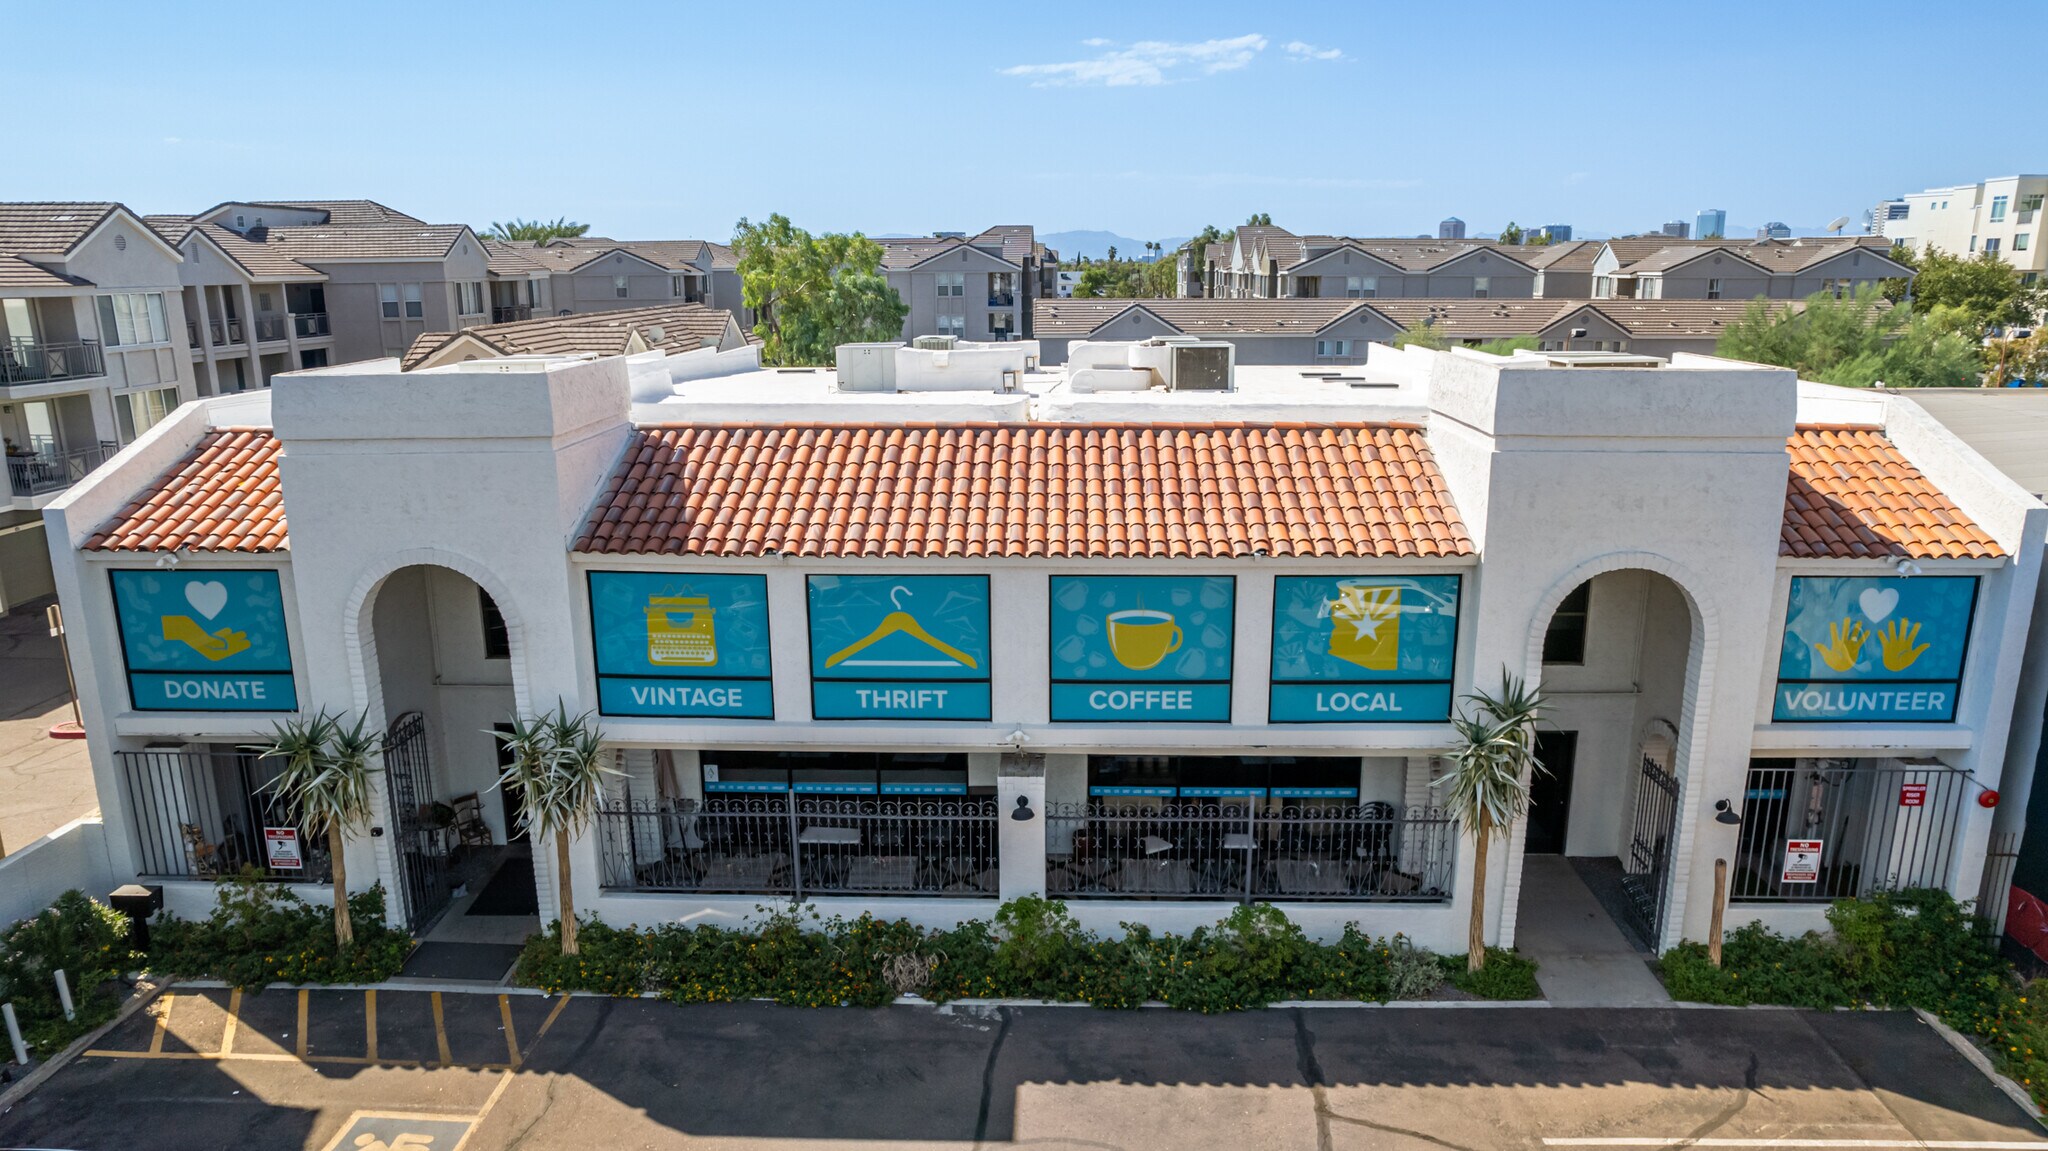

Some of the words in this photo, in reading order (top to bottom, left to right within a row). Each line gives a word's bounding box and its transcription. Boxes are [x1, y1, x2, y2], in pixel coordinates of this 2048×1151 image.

[164, 680, 266, 701] DONATE
[631, 687, 743, 708] VINTAGE
[856, 689, 948, 709] THRIFT
[1088, 690, 1192, 711] COFFEE
[1784, 689, 1946, 712] VOLUNTEER
[1316, 692, 1402, 712] LOCAL
